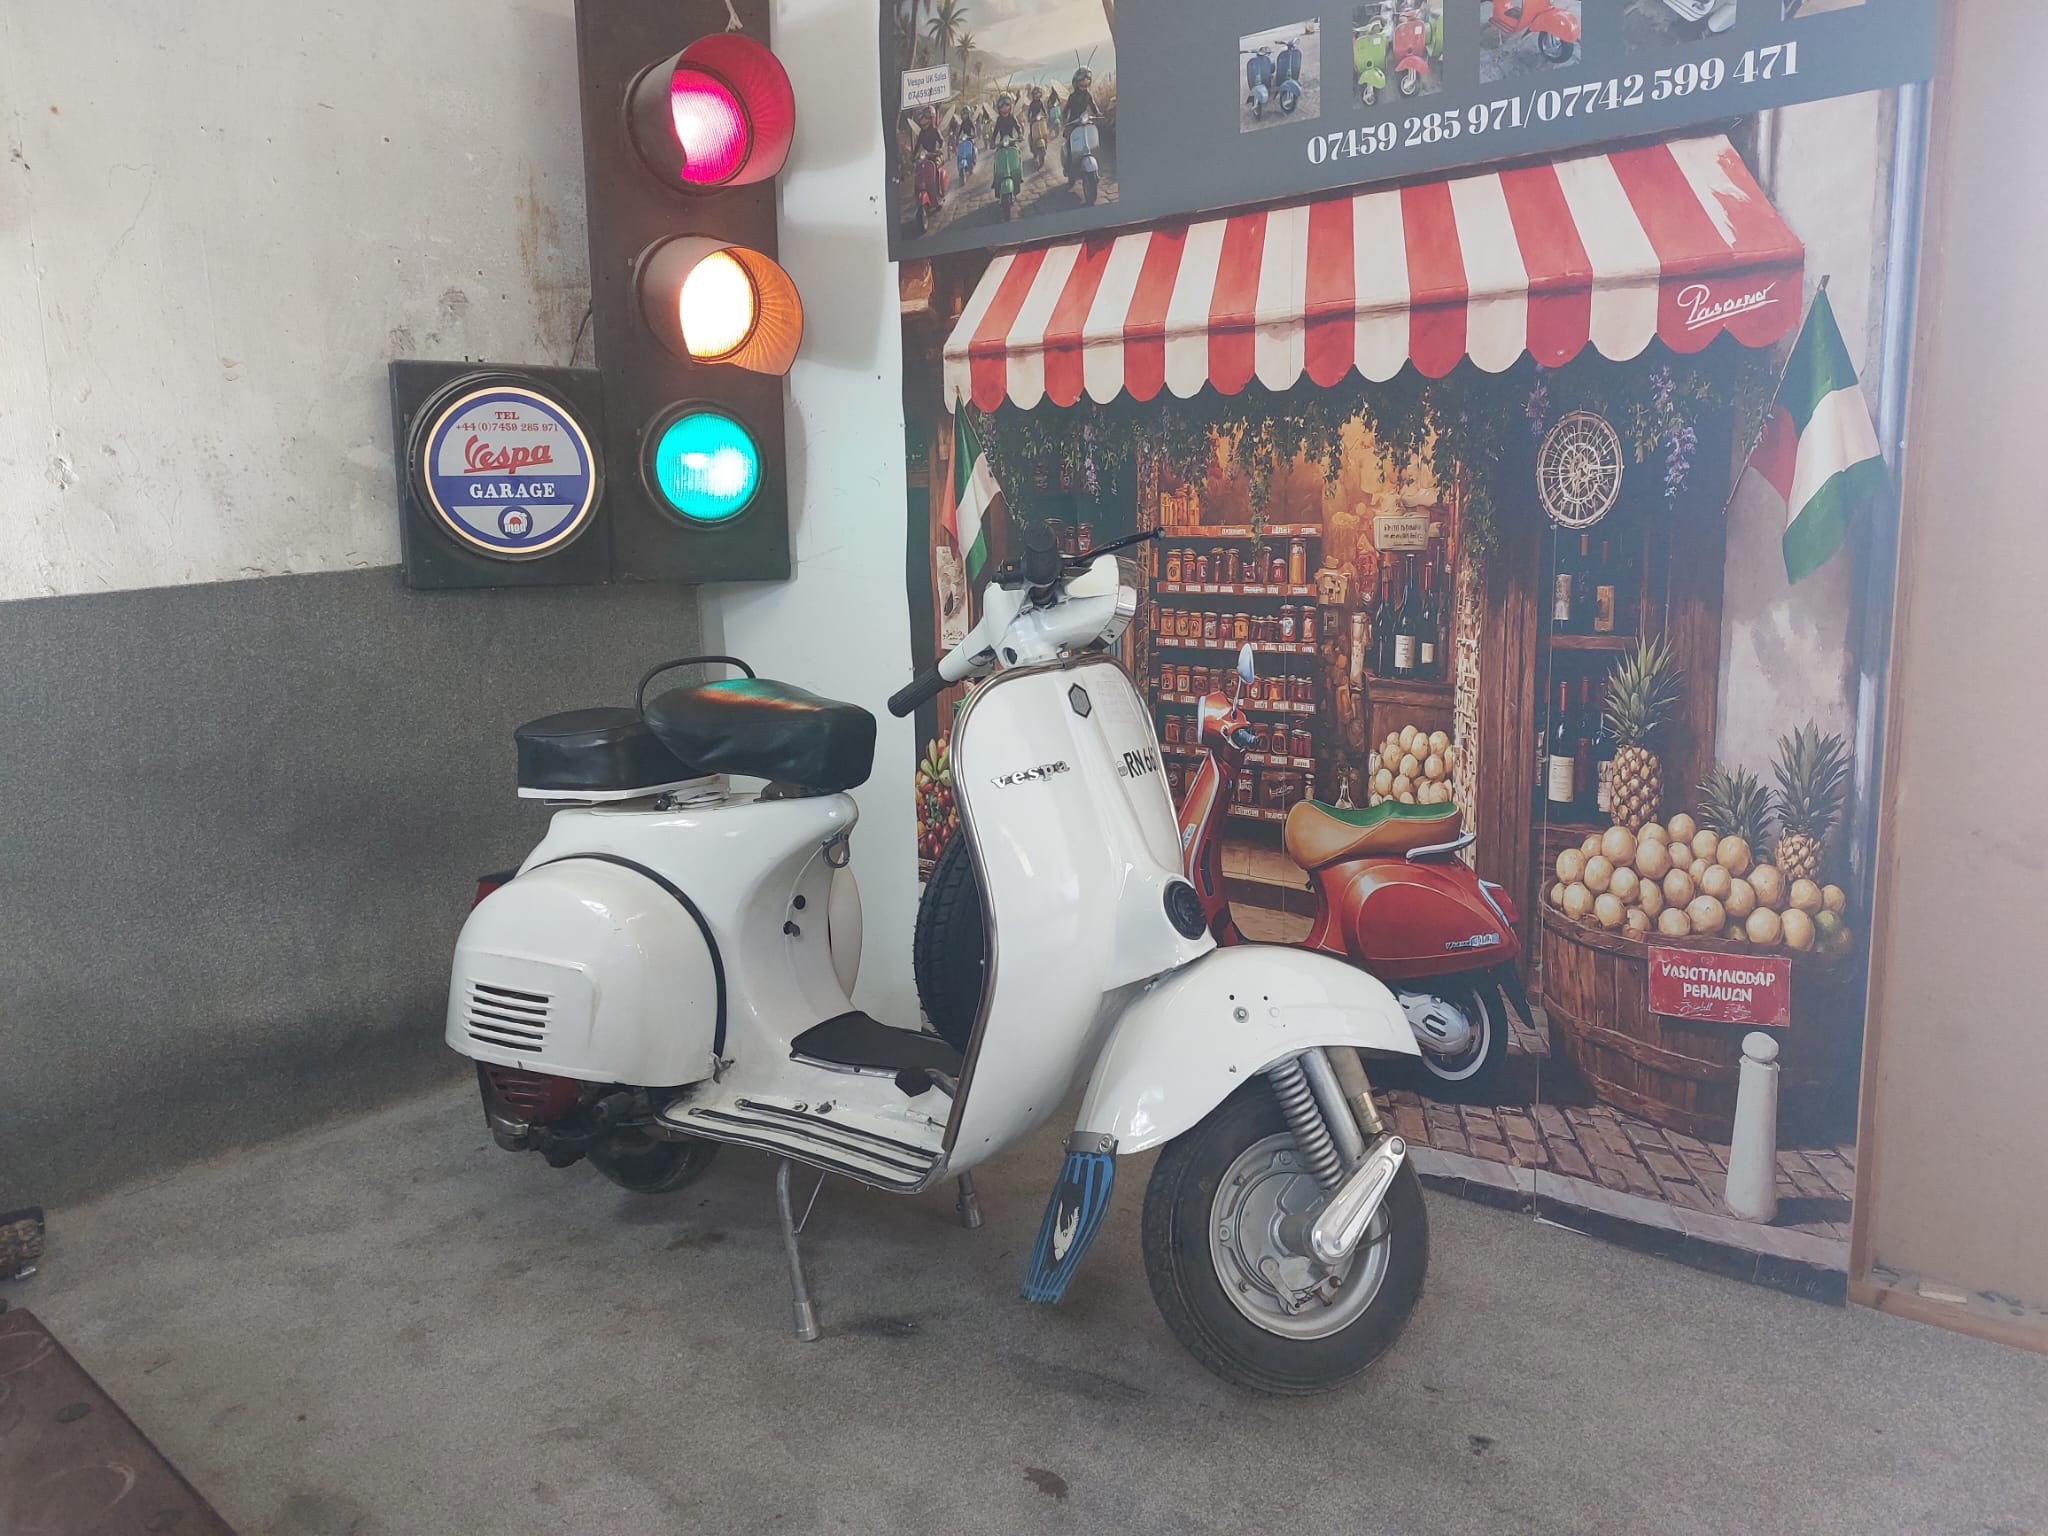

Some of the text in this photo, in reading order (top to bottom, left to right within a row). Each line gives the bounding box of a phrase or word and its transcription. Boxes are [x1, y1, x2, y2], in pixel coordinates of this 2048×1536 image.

[1307, 41, 1799, 165] 07459 285 971/07742 599 471
[495, 412, 520, 420] TEL
[521, 423, 539, 432] 285
[542, 423, 558, 432] 971
[464, 434, 553, 474] Vespa
[469, 483, 555, 498] GARAGE
